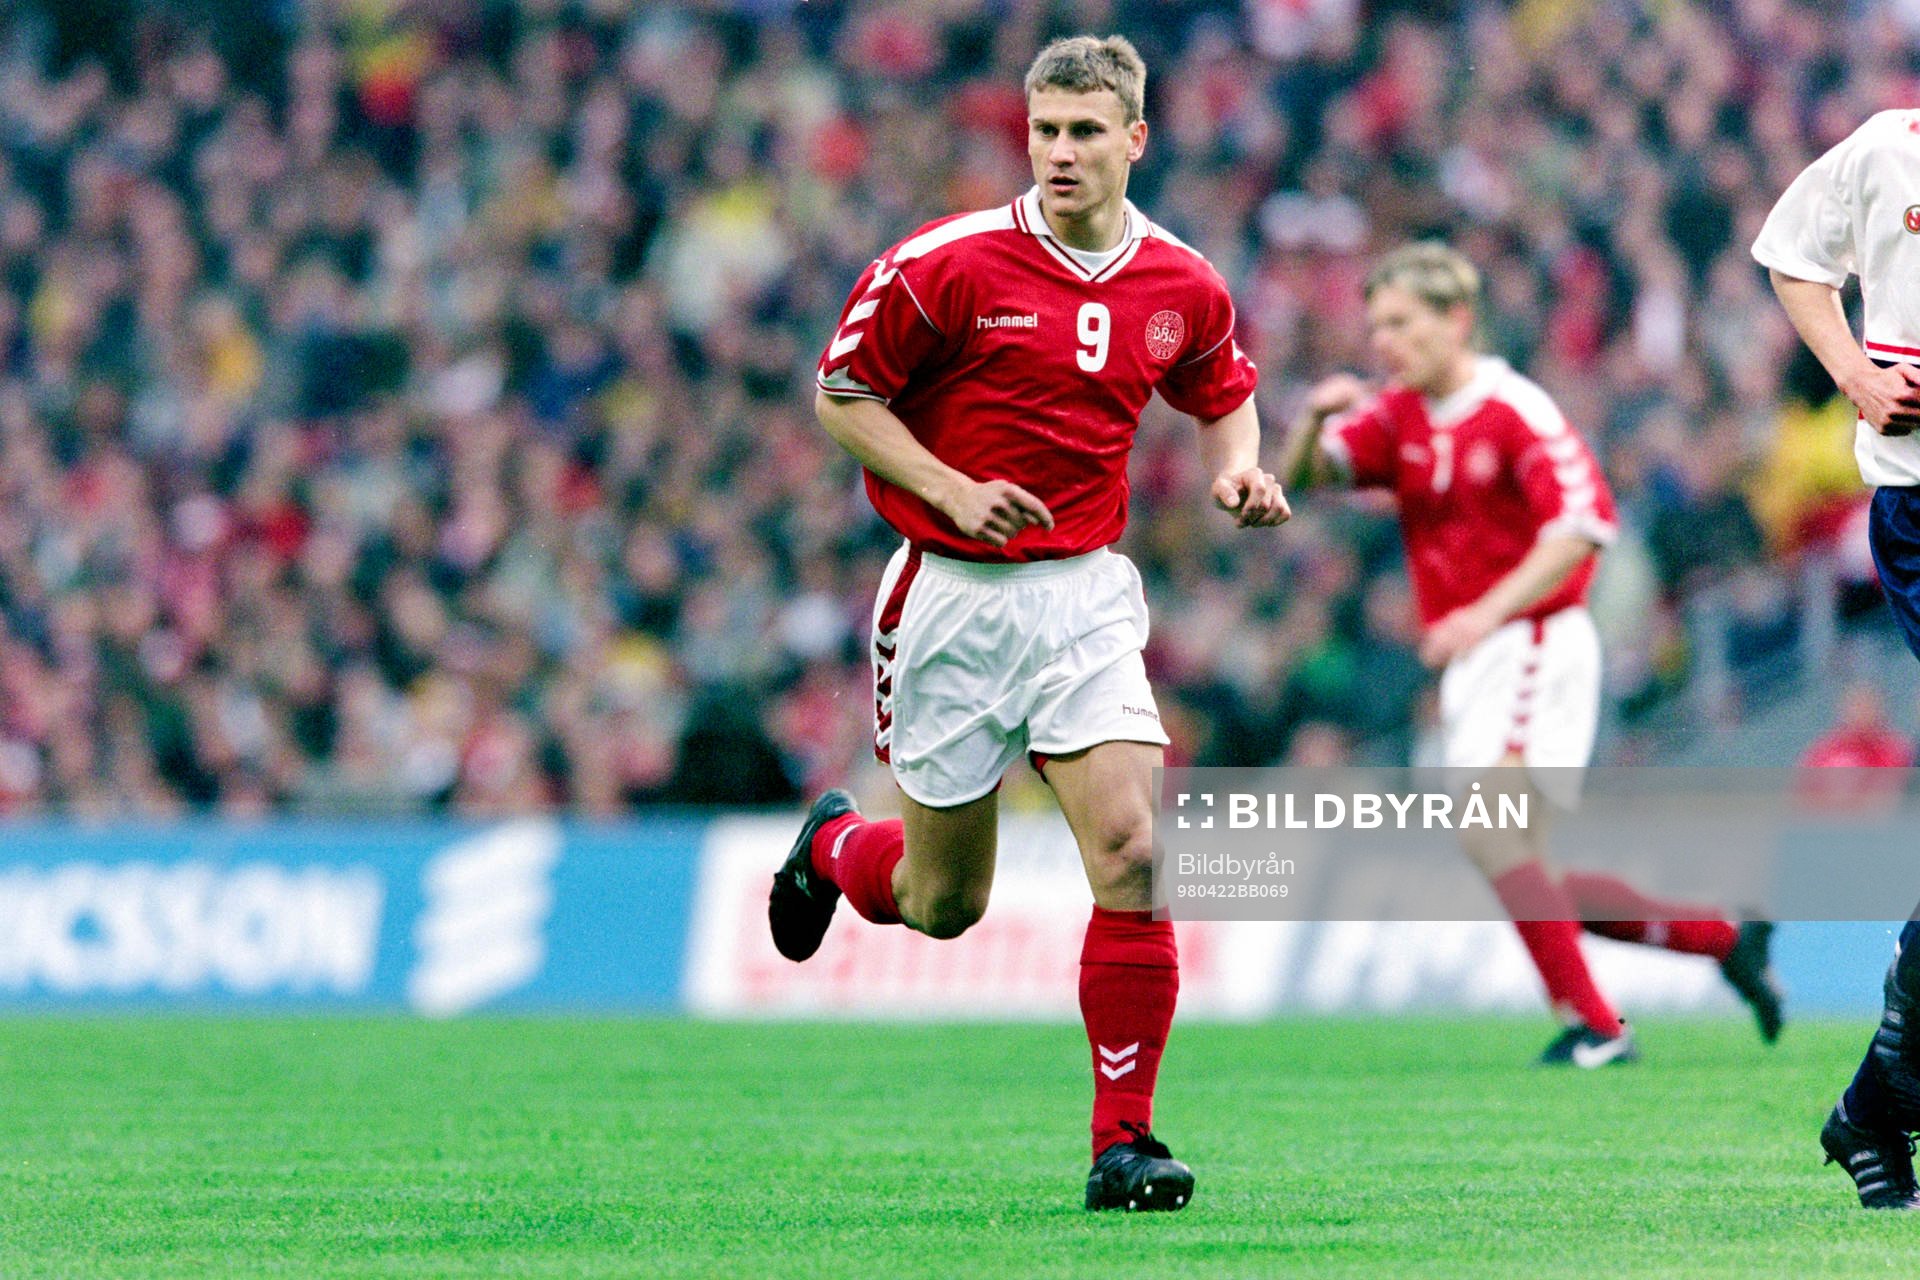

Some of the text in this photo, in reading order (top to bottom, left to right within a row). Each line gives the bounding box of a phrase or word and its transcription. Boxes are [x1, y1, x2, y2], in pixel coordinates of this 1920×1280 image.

[977, 313, 1038, 329] hummel
[1076, 302, 1111, 372] 9
[1153, 326, 1178, 343] DBU
